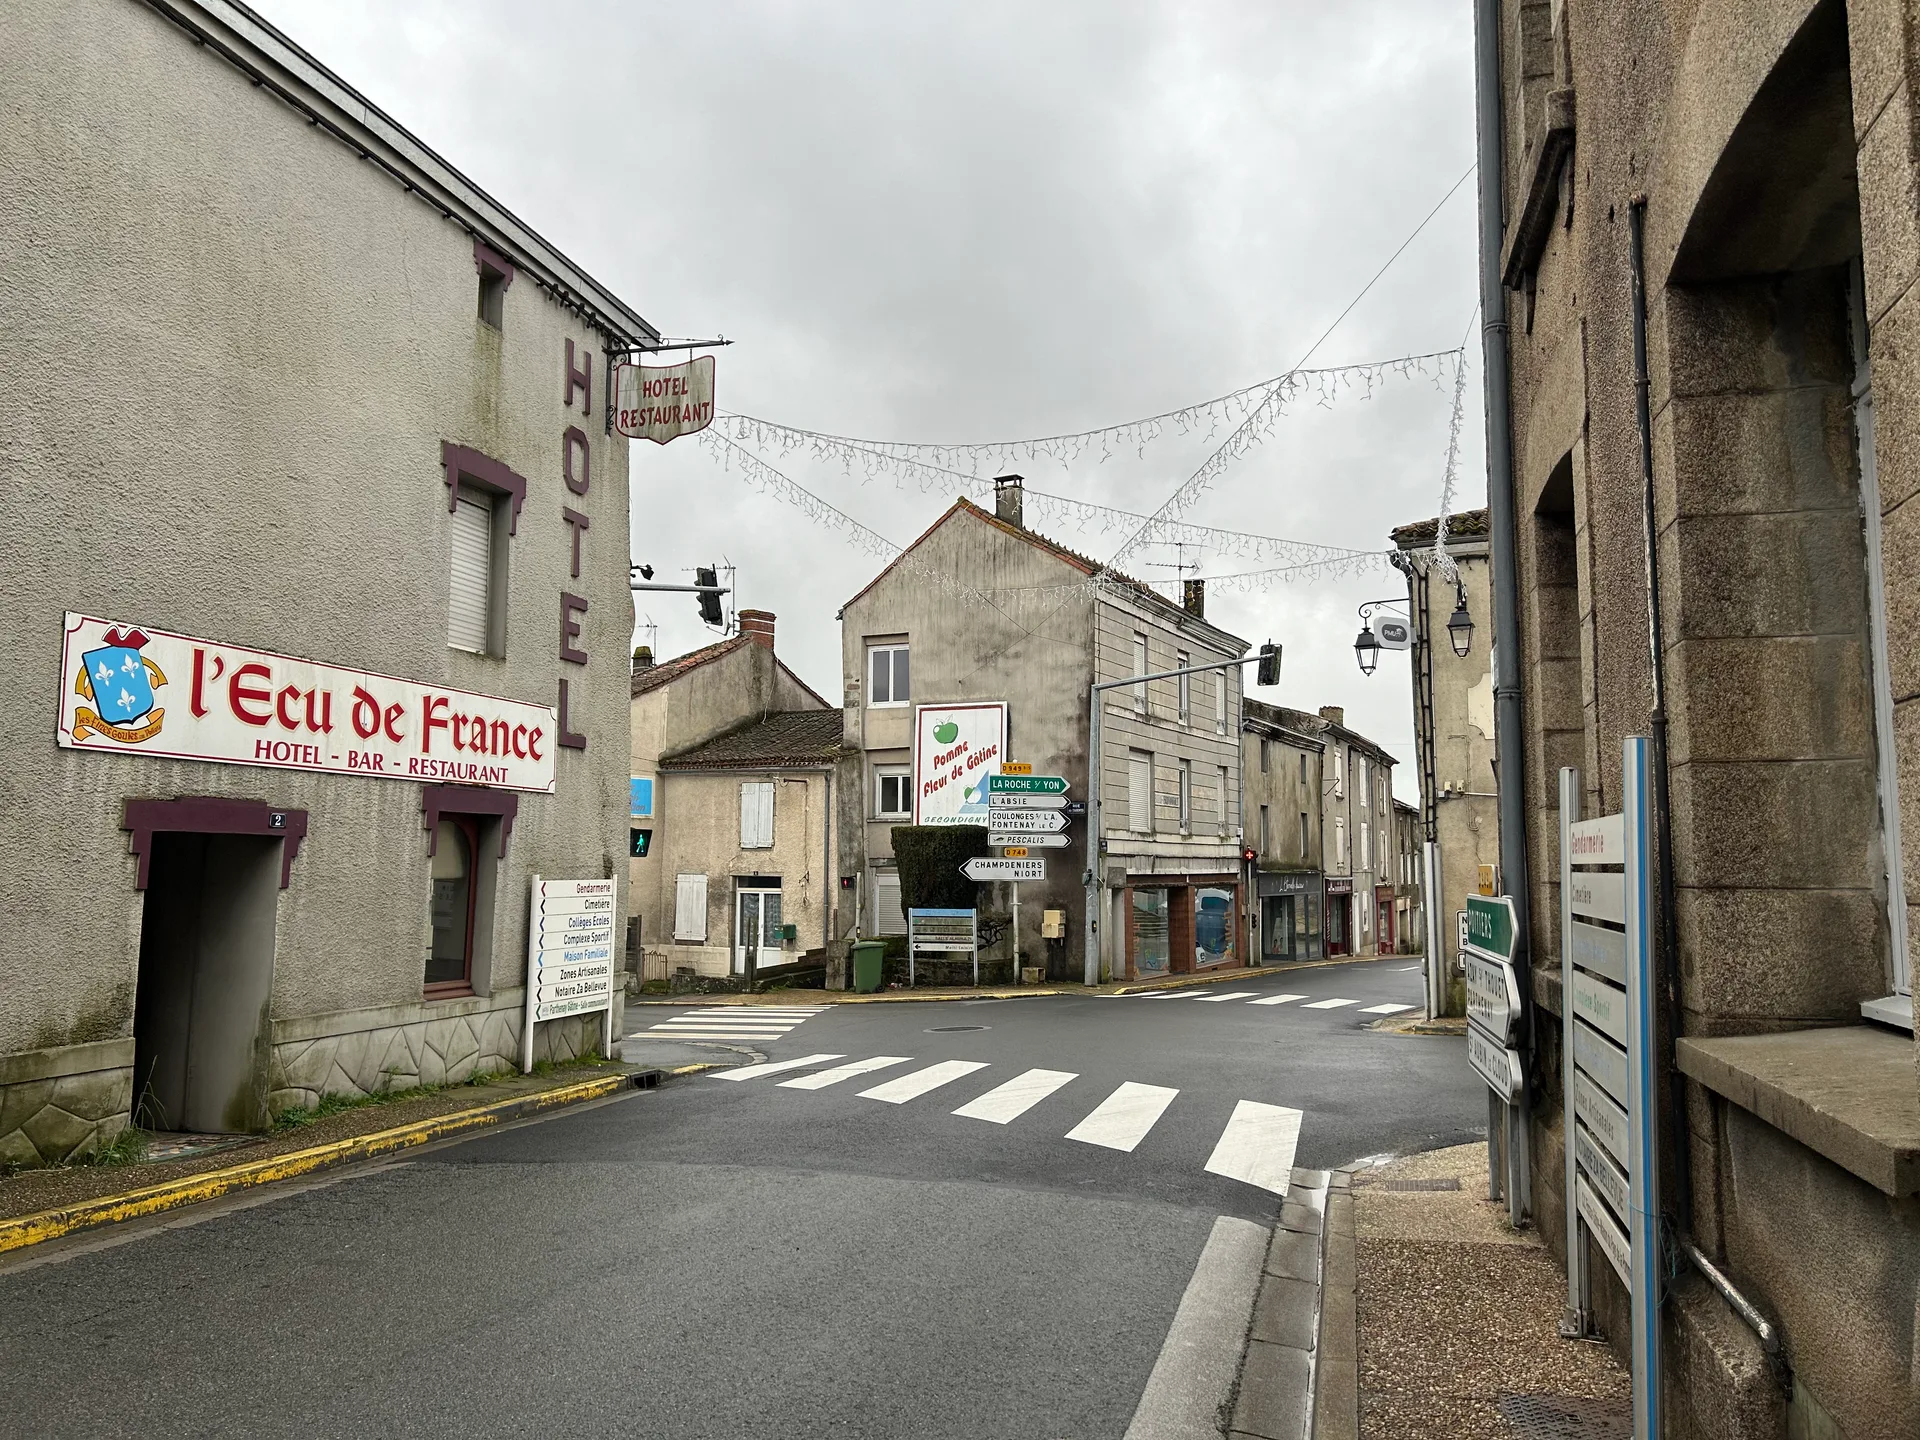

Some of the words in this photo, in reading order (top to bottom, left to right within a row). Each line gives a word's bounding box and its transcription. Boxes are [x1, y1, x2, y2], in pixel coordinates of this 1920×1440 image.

[642, 377, 688, 398] HOTEL
[620, 401, 710, 428] RESTAURANT
[557, 337, 592, 749] HOTEL
[1384, 629, 1397, 637] PMU
[351, 685, 405, 743] de
[422, 695, 544, 761] France
[254, 740, 322, 764] HOTEL
[348, 750, 384, 771] BAR
[408, 758, 508, 783] RESTAURANT
[934, 741, 968, 770] Pomme
[967, 744, 997, 770] Gâtine
[951, 765, 963, 780] de
[992, 780, 1003, 789] LA
[1004, 780, 1031, 789] ROCHE
[1043, 781, 1060, 790] YON
[274, 815, 282, 826] 2
[1572, 828, 1604, 855] Gendarmerie
[577, 882, 610, 894] Gendarmerie
[1572, 884, 1591, 905] Cimetière
[584, 898, 610, 909] Cimetière
[568, 916, 592, 929] Collèges
[1469, 909, 1492, 939] POITIERS
[563, 934, 590, 946] Complexe
[591, 931, 609, 944] Sportif
[564, 951, 583, 962] Maison
[584, 948, 608, 959] Familiale
[560, 969, 577, 980] Zones
[577, 965, 608, 978] Artisanales
[555, 985, 576, 998] Notaire
[577, 983, 584, 994] Za
[584, 981, 607, 993] Bellevue
[1485, 970, 1504, 1001] THOUET
[1468, 987, 1493, 1023] PARTHENAY
[1474, 1038, 1487, 1068] AUBIN
[1492, 1054, 1508, 1087] CLOUD
[1575, 1083, 1588, 1112] Zones
[1588, 1097, 1614, 1141] Artisanales
[1601, 1164, 1624, 1213] BELLEVUE
